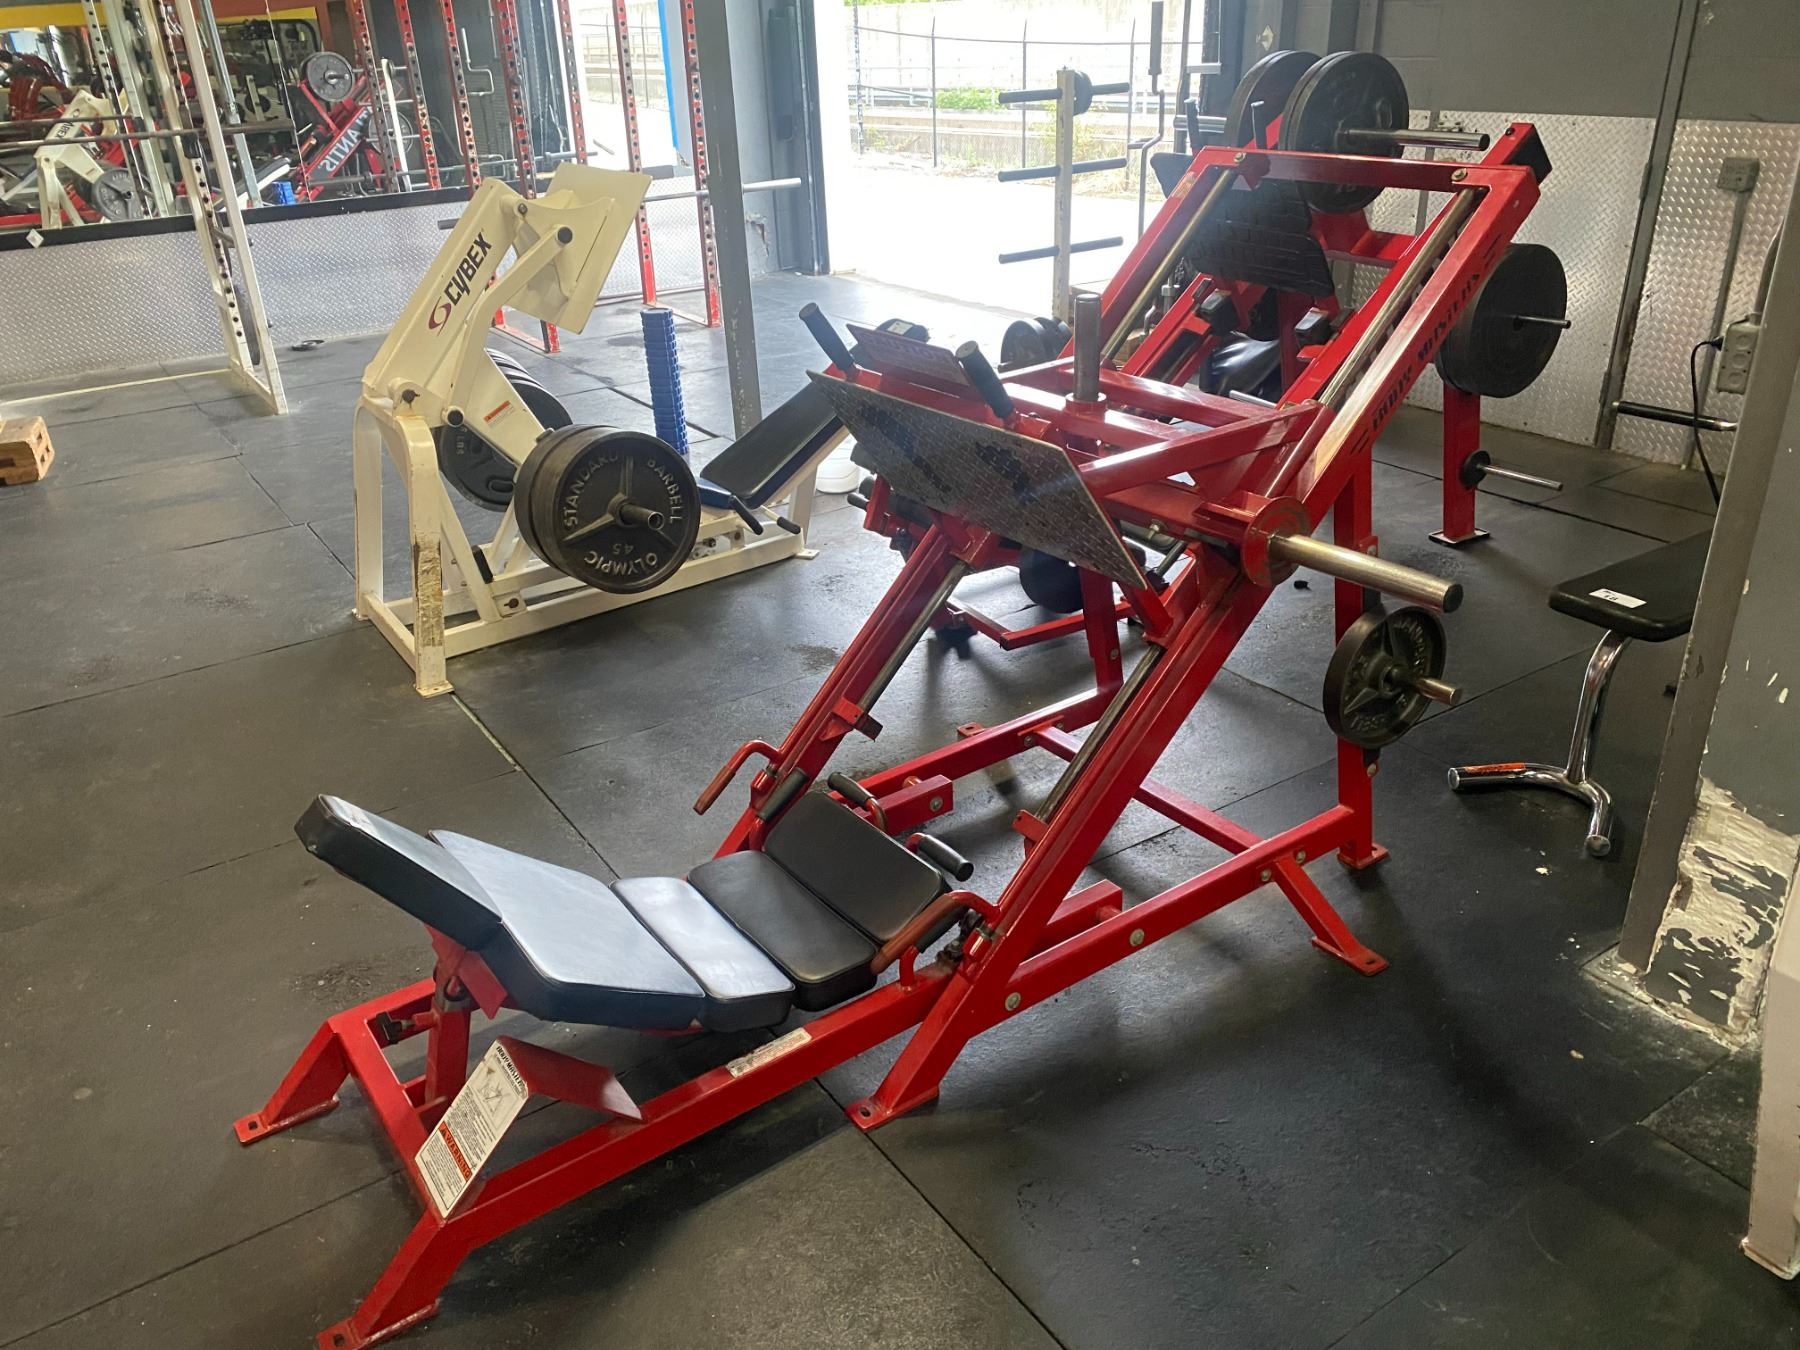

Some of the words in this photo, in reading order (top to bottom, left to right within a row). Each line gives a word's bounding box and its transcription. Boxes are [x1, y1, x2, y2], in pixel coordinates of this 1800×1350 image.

[444, 232, 492, 306] CYBEX
[563, 450, 619, 529] STANDARD
[647, 459, 683, 525] BARBELL
[584, 551, 658, 576] OLYMPIC
[446, 1132, 472, 1181] WARNING
